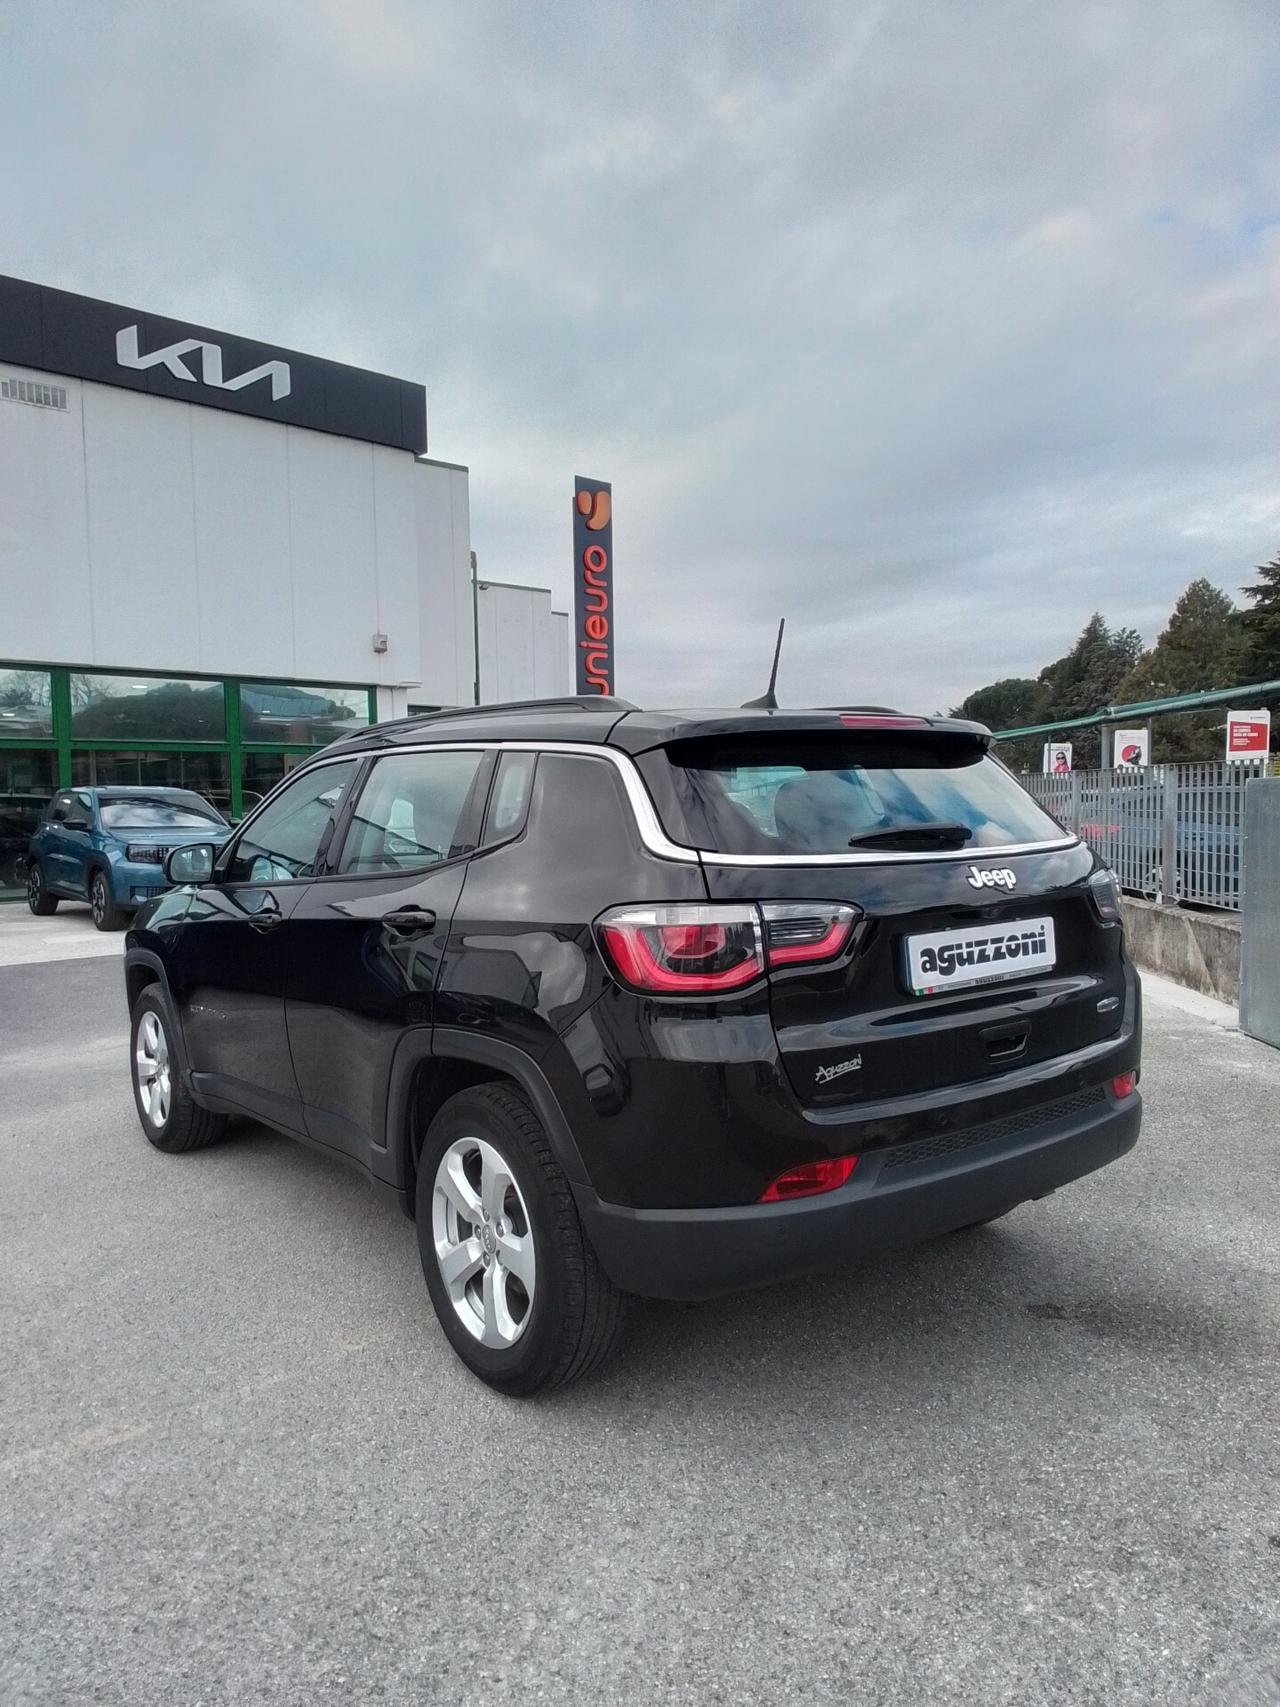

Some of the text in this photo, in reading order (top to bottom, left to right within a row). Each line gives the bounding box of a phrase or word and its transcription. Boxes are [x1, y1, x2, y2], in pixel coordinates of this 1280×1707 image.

[580, 545, 609, 696] unieuro
[967, 865, 1017, 891] Jeep
[920, 924, 1047, 976] aguzzoni
